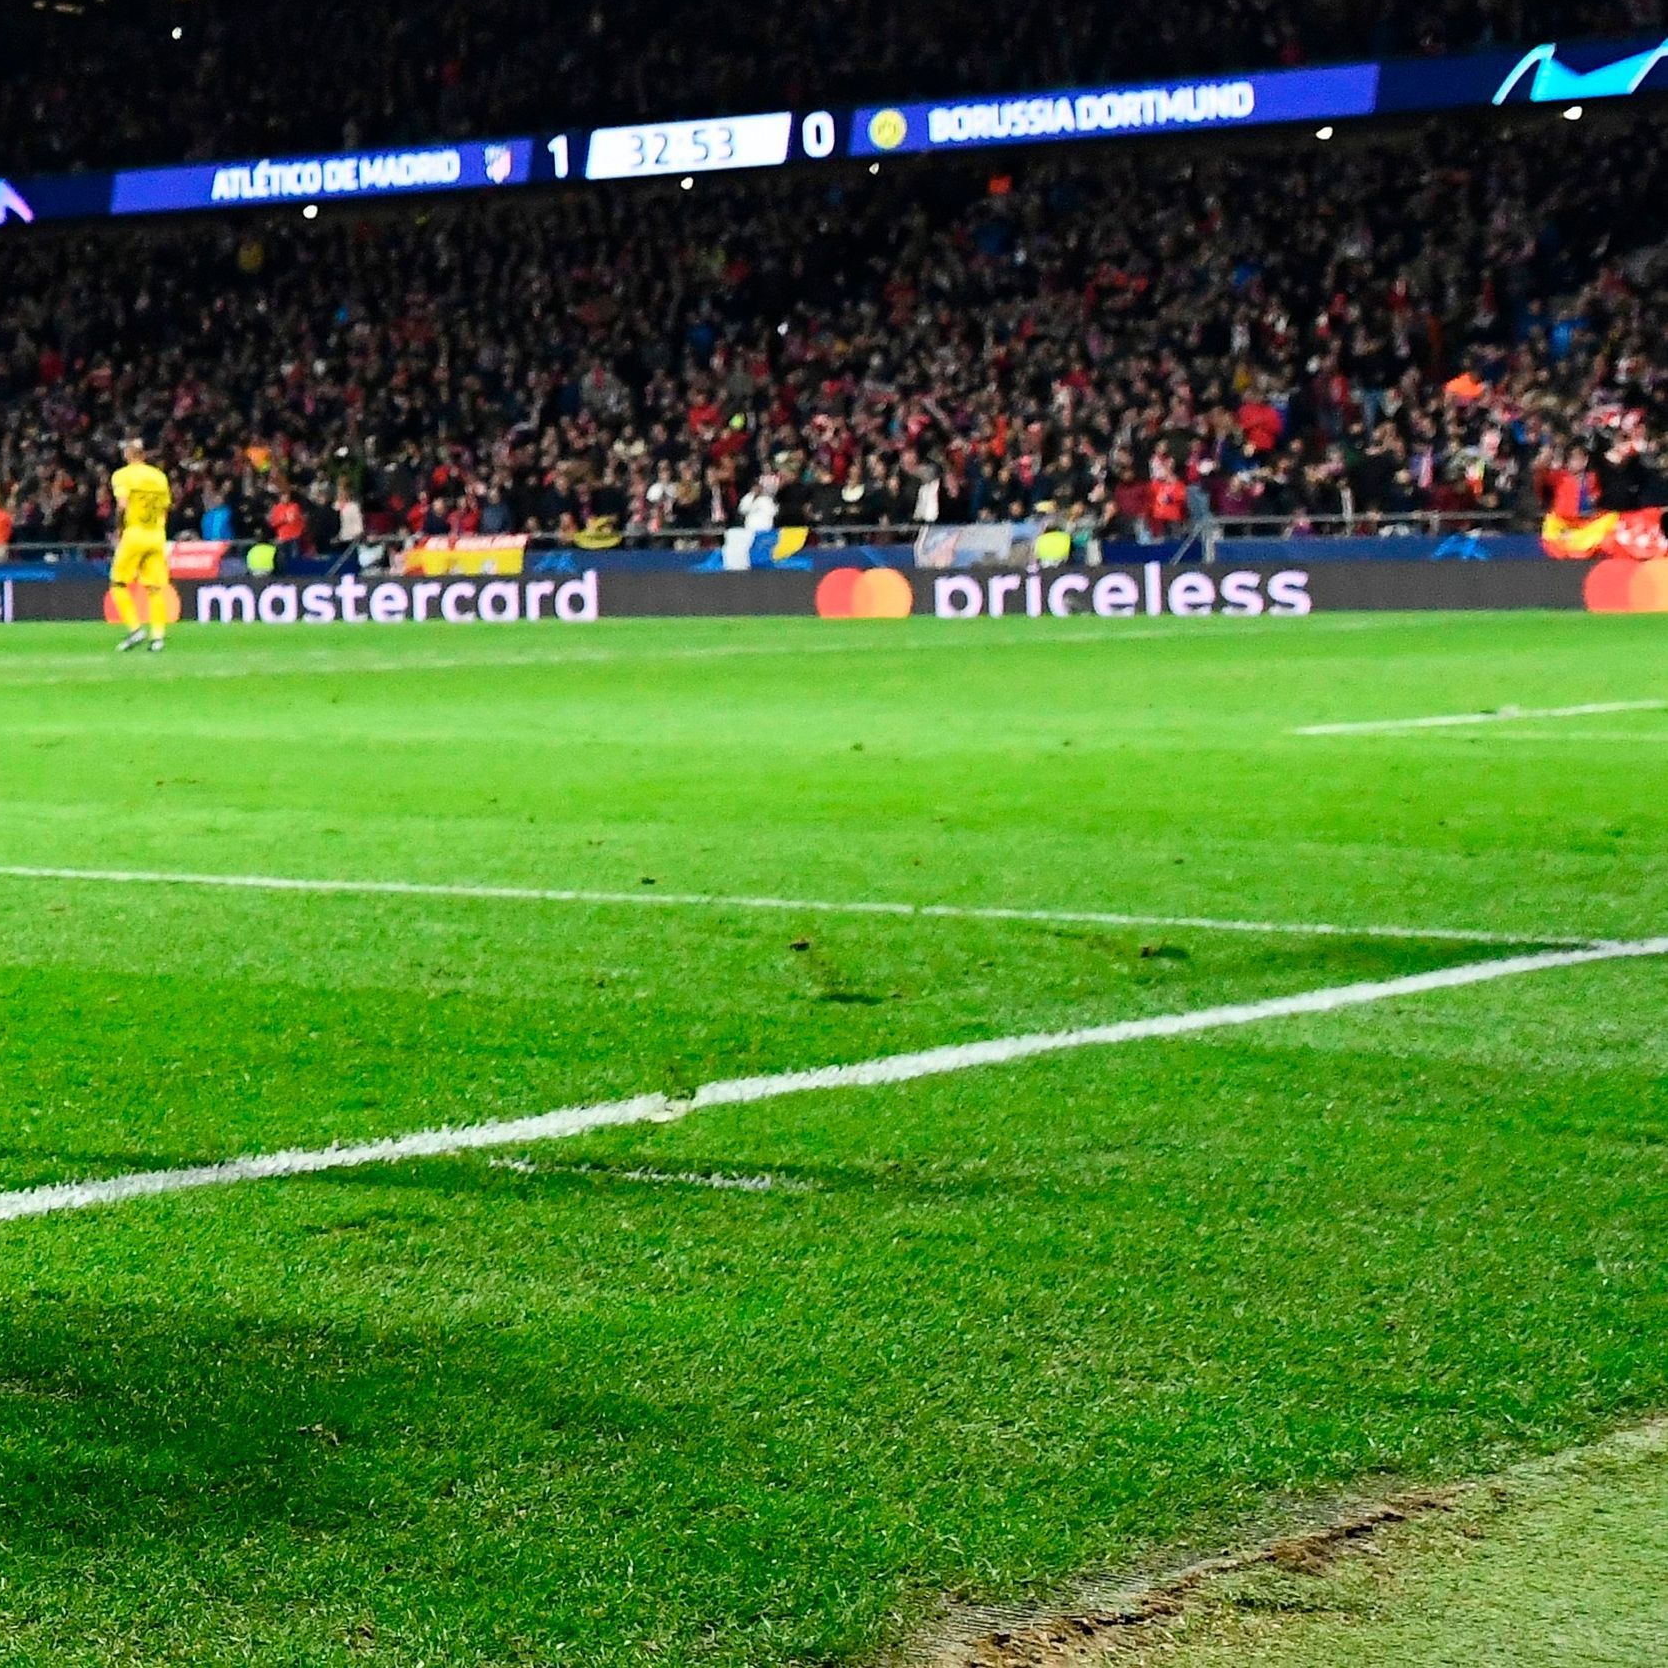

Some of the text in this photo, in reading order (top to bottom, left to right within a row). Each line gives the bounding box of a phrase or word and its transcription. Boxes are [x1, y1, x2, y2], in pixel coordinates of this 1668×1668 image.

[211, 158, 322, 201] ATLÉTICO
[323, 157, 359, 192] DE
[359, 149, 461, 190] MADRID
[547, 133, 569, 179] 1
[801, 109, 836, 158] 0
[927, 96, 1075, 143] BORUSSIA
[1075, 80, 1255, 131] DORTMUND
[196, 569, 599, 624] mastercard
[933, 561, 1312, 619] priceless
